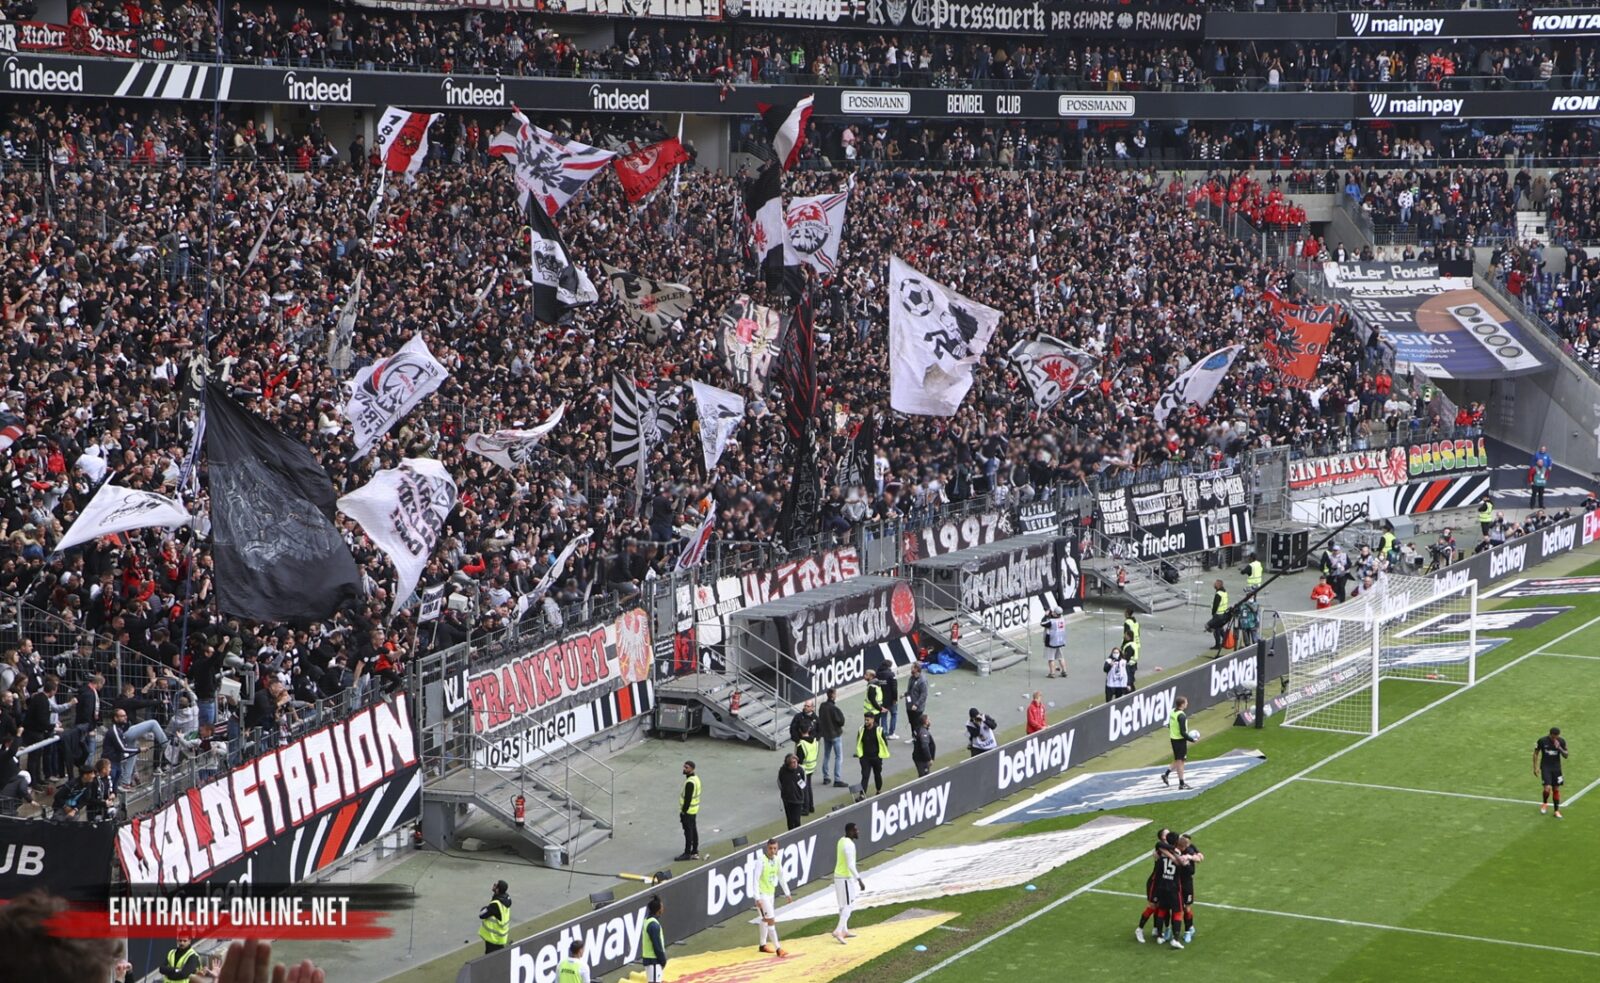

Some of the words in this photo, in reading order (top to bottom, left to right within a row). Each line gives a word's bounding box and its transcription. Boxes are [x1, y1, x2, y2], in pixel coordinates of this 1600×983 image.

[929, 0, 1046, 31] Presswerk
[1051, 12, 1072, 30] PER
[1073, 11, 1114, 30] SEMPRE
[1135, 11, 1202, 31] FRANKFURT
[1371, 15, 1444, 35] mainpay
[7, 60, 83, 92] indeed
[287, 75, 352, 102] indeed
[445, 82, 504, 106] indeed
[593, 88, 650, 110] indeed
[848, 95, 905, 109] POSSMANN
[947, 94, 985, 114] BEMBEL
[996, 95, 1021, 114] CLUB
[1066, 99, 1128, 112] POSSMANN
[1389, 96, 1464, 116] mainpay
[1551, 95, 1600, 111] KON
[1288, 449, 1389, 482] EINTRACHT
[1320, 495, 1370, 523] indeed
[922, 513, 999, 558] 1997
[1143, 529, 1186, 556] finden
[1541, 523, 1577, 557] betway
[1489, 543, 1527, 579] betway
[742, 547, 861, 608] ULTRAS
[792, 591, 891, 664] Eintracht
[1291, 619, 1342, 663] betway
[469, 626, 610, 734] FRANKFURT
[810, 648, 864, 693] indeed
[526, 709, 576, 748] finden
[1109, 686, 1177, 742] betway
[998, 728, 1076, 790] betway
[116, 692, 418, 884] WALDSTADION
[871, 780, 951, 843] betway
[1162, 857, 1177, 875] 15
